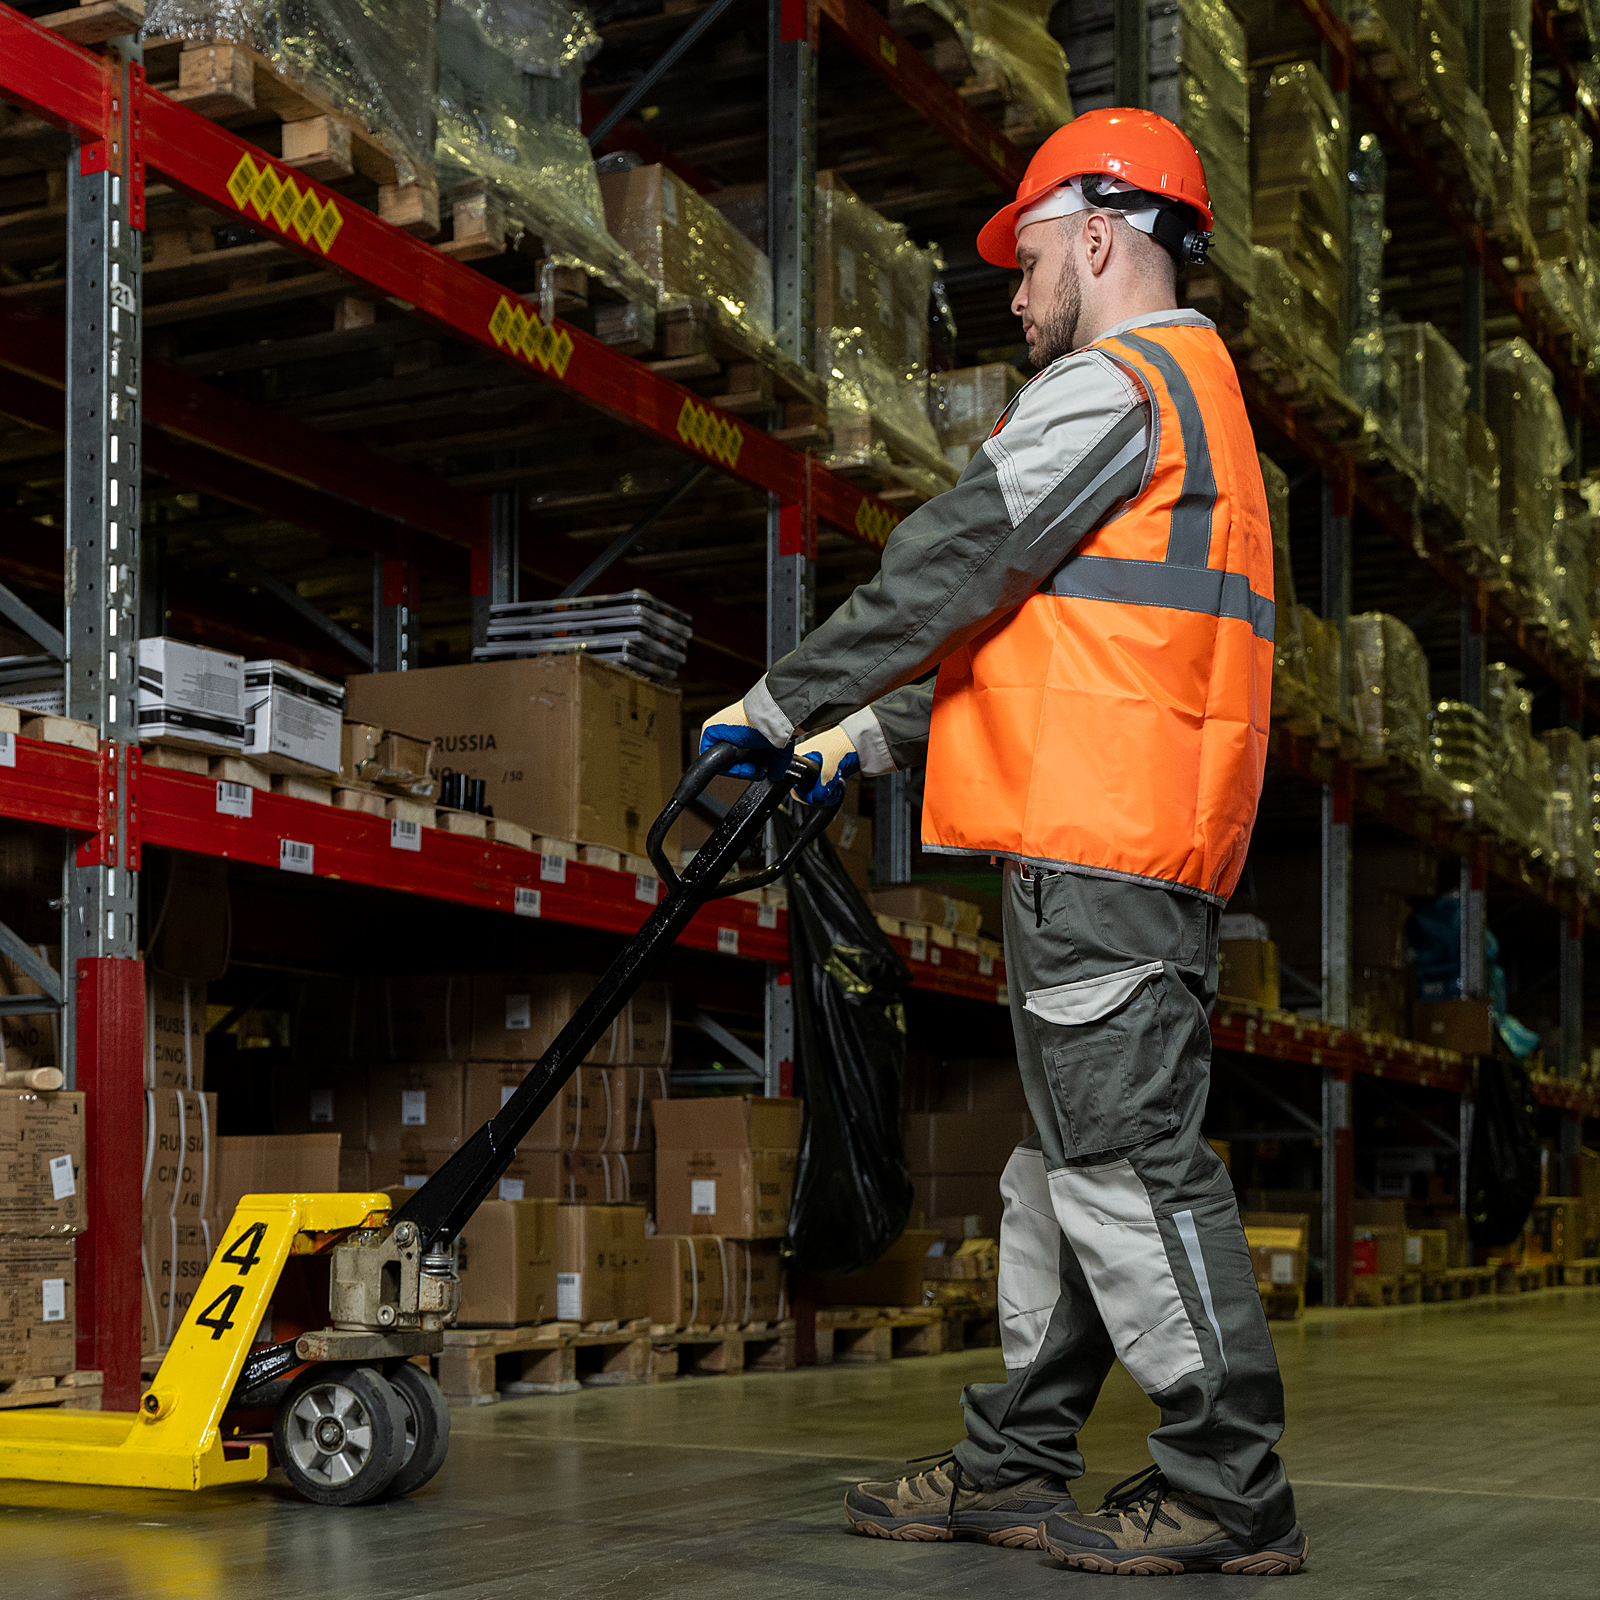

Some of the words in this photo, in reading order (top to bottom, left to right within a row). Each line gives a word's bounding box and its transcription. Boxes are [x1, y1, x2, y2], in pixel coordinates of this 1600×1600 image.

[113, 286, 130, 305] 21
[434, 734, 496, 752] RUSSIA
[155, 1015, 198, 1034] RUSSA
[221, 1222, 268, 1275] 4
[196, 1285, 243, 1341] 4
